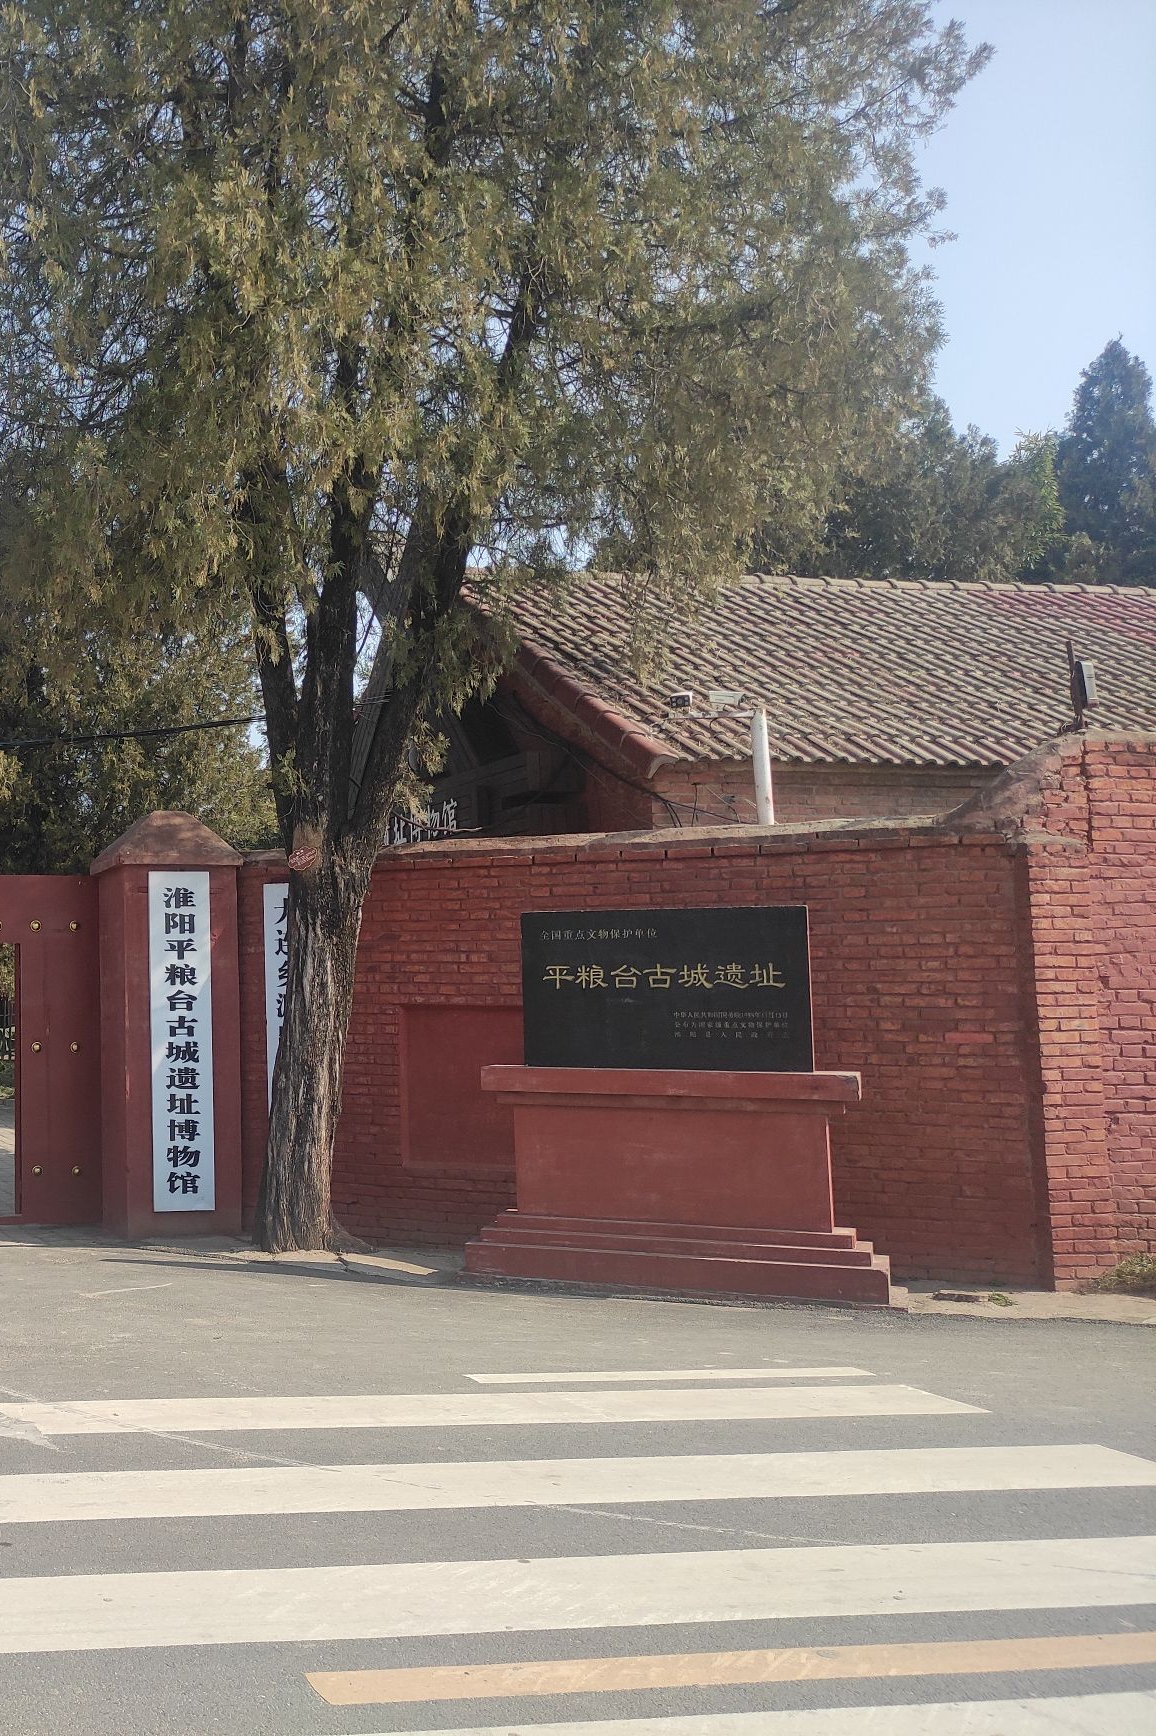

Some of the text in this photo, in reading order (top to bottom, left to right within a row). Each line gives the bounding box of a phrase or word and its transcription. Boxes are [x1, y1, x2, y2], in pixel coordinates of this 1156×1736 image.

[540, 928, 658, 941] 全国重点文物保护单位
[542, 962, 786, 990] 平粮台古城遗址
[163, 887, 201, 1195] 淮阳平粮台古城遗址博物馆
